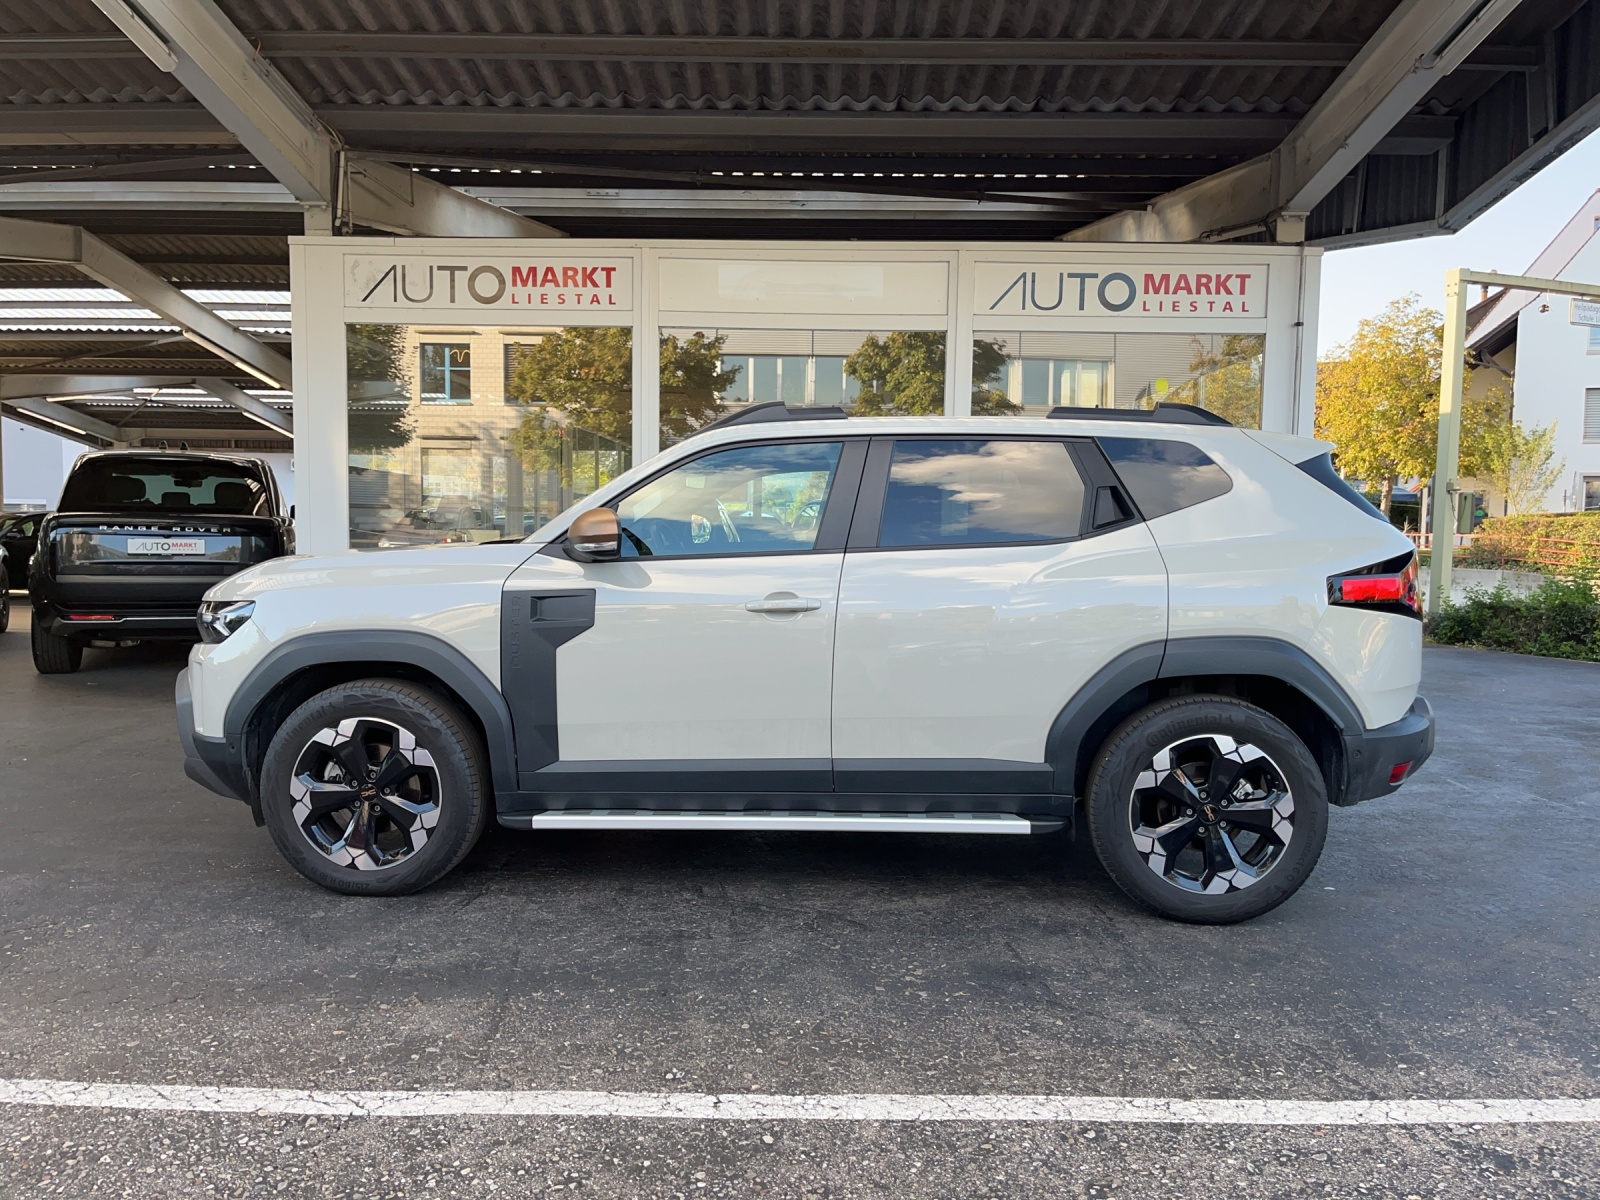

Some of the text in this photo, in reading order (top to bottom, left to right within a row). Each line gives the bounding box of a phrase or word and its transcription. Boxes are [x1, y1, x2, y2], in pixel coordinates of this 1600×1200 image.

[360, 264, 617, 305] AUTO MARKT
[989, 271, 1251, 313] AUTO MARKT
[511, 293, 617, 305] LIESTAL
[1142, 301, 1250, 313] LIESTAL
[136, 542, 171, 552] AUTO
